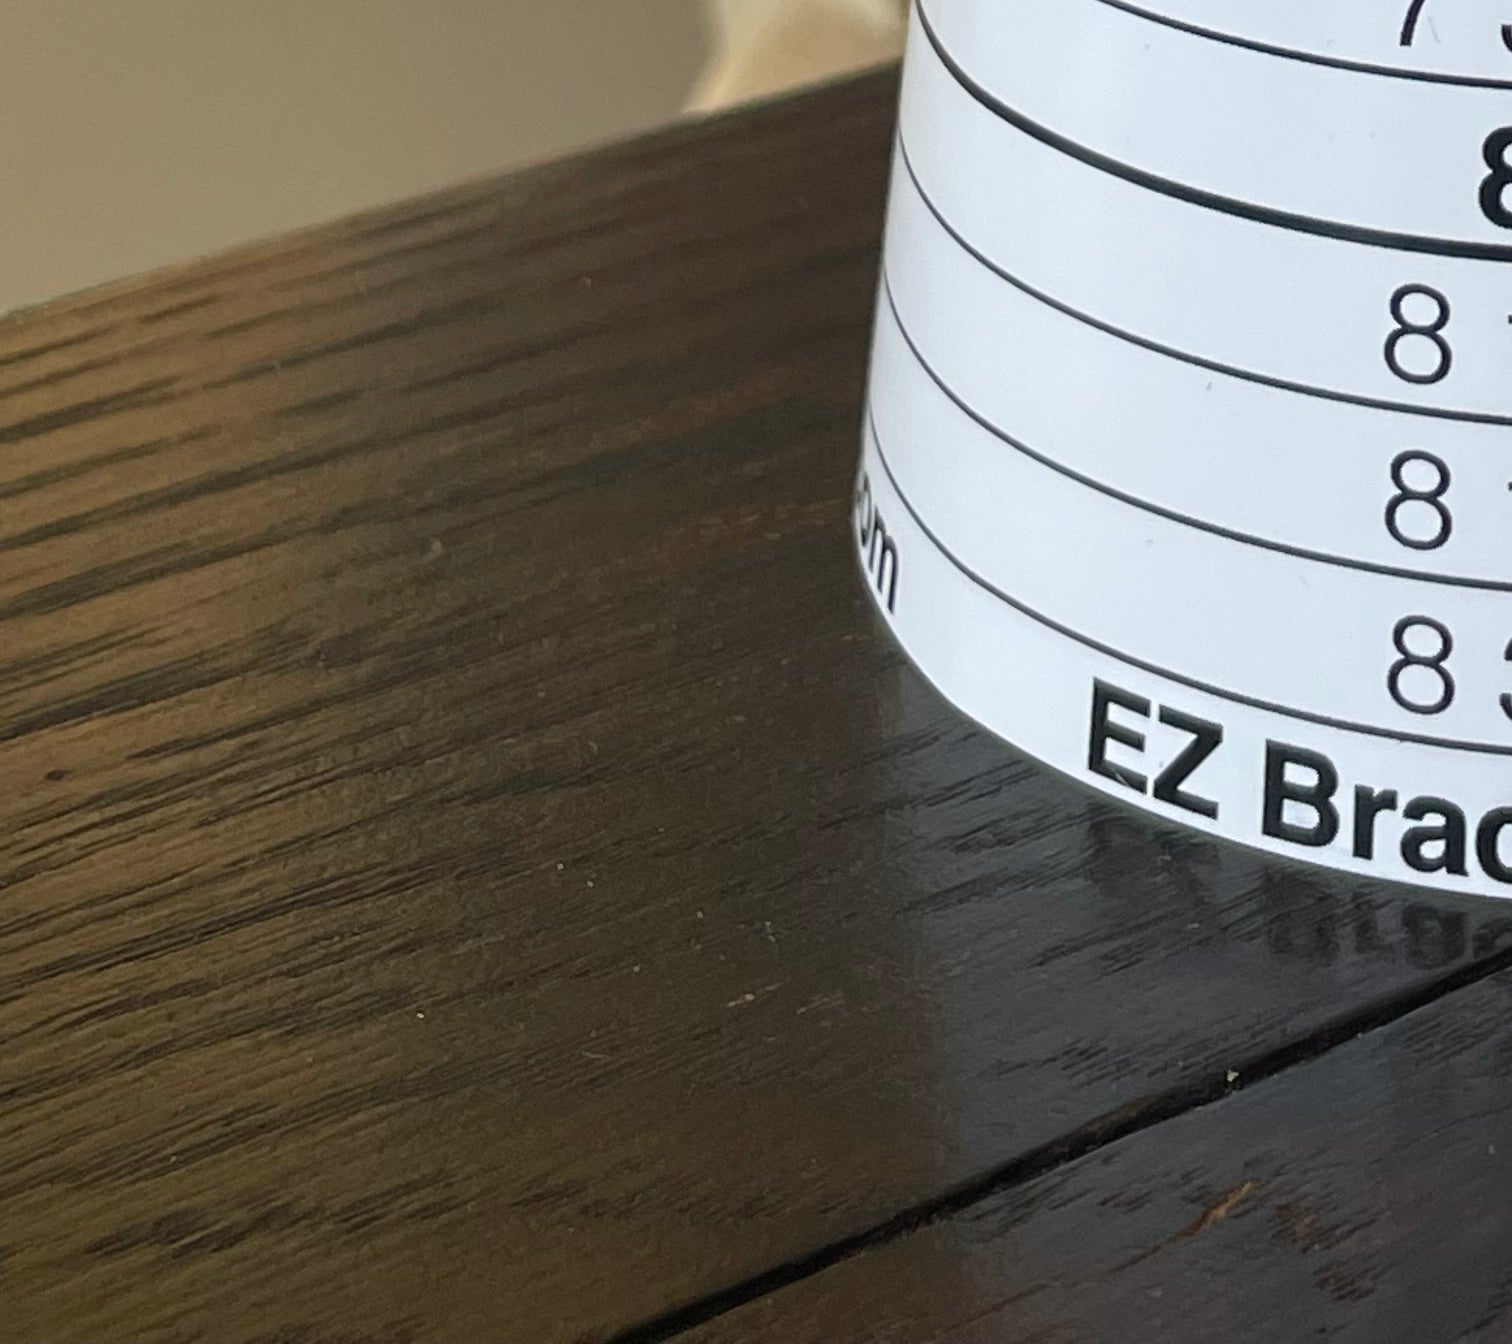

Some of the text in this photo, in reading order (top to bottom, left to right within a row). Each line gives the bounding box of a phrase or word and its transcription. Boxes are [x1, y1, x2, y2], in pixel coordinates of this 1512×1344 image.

[1383, 283, 1453, 386] 8
[1383, 449, 1453, 552] 8
[1386, 615, 1456, 716] 8
[1087, 676, 1224, 820] EZ
